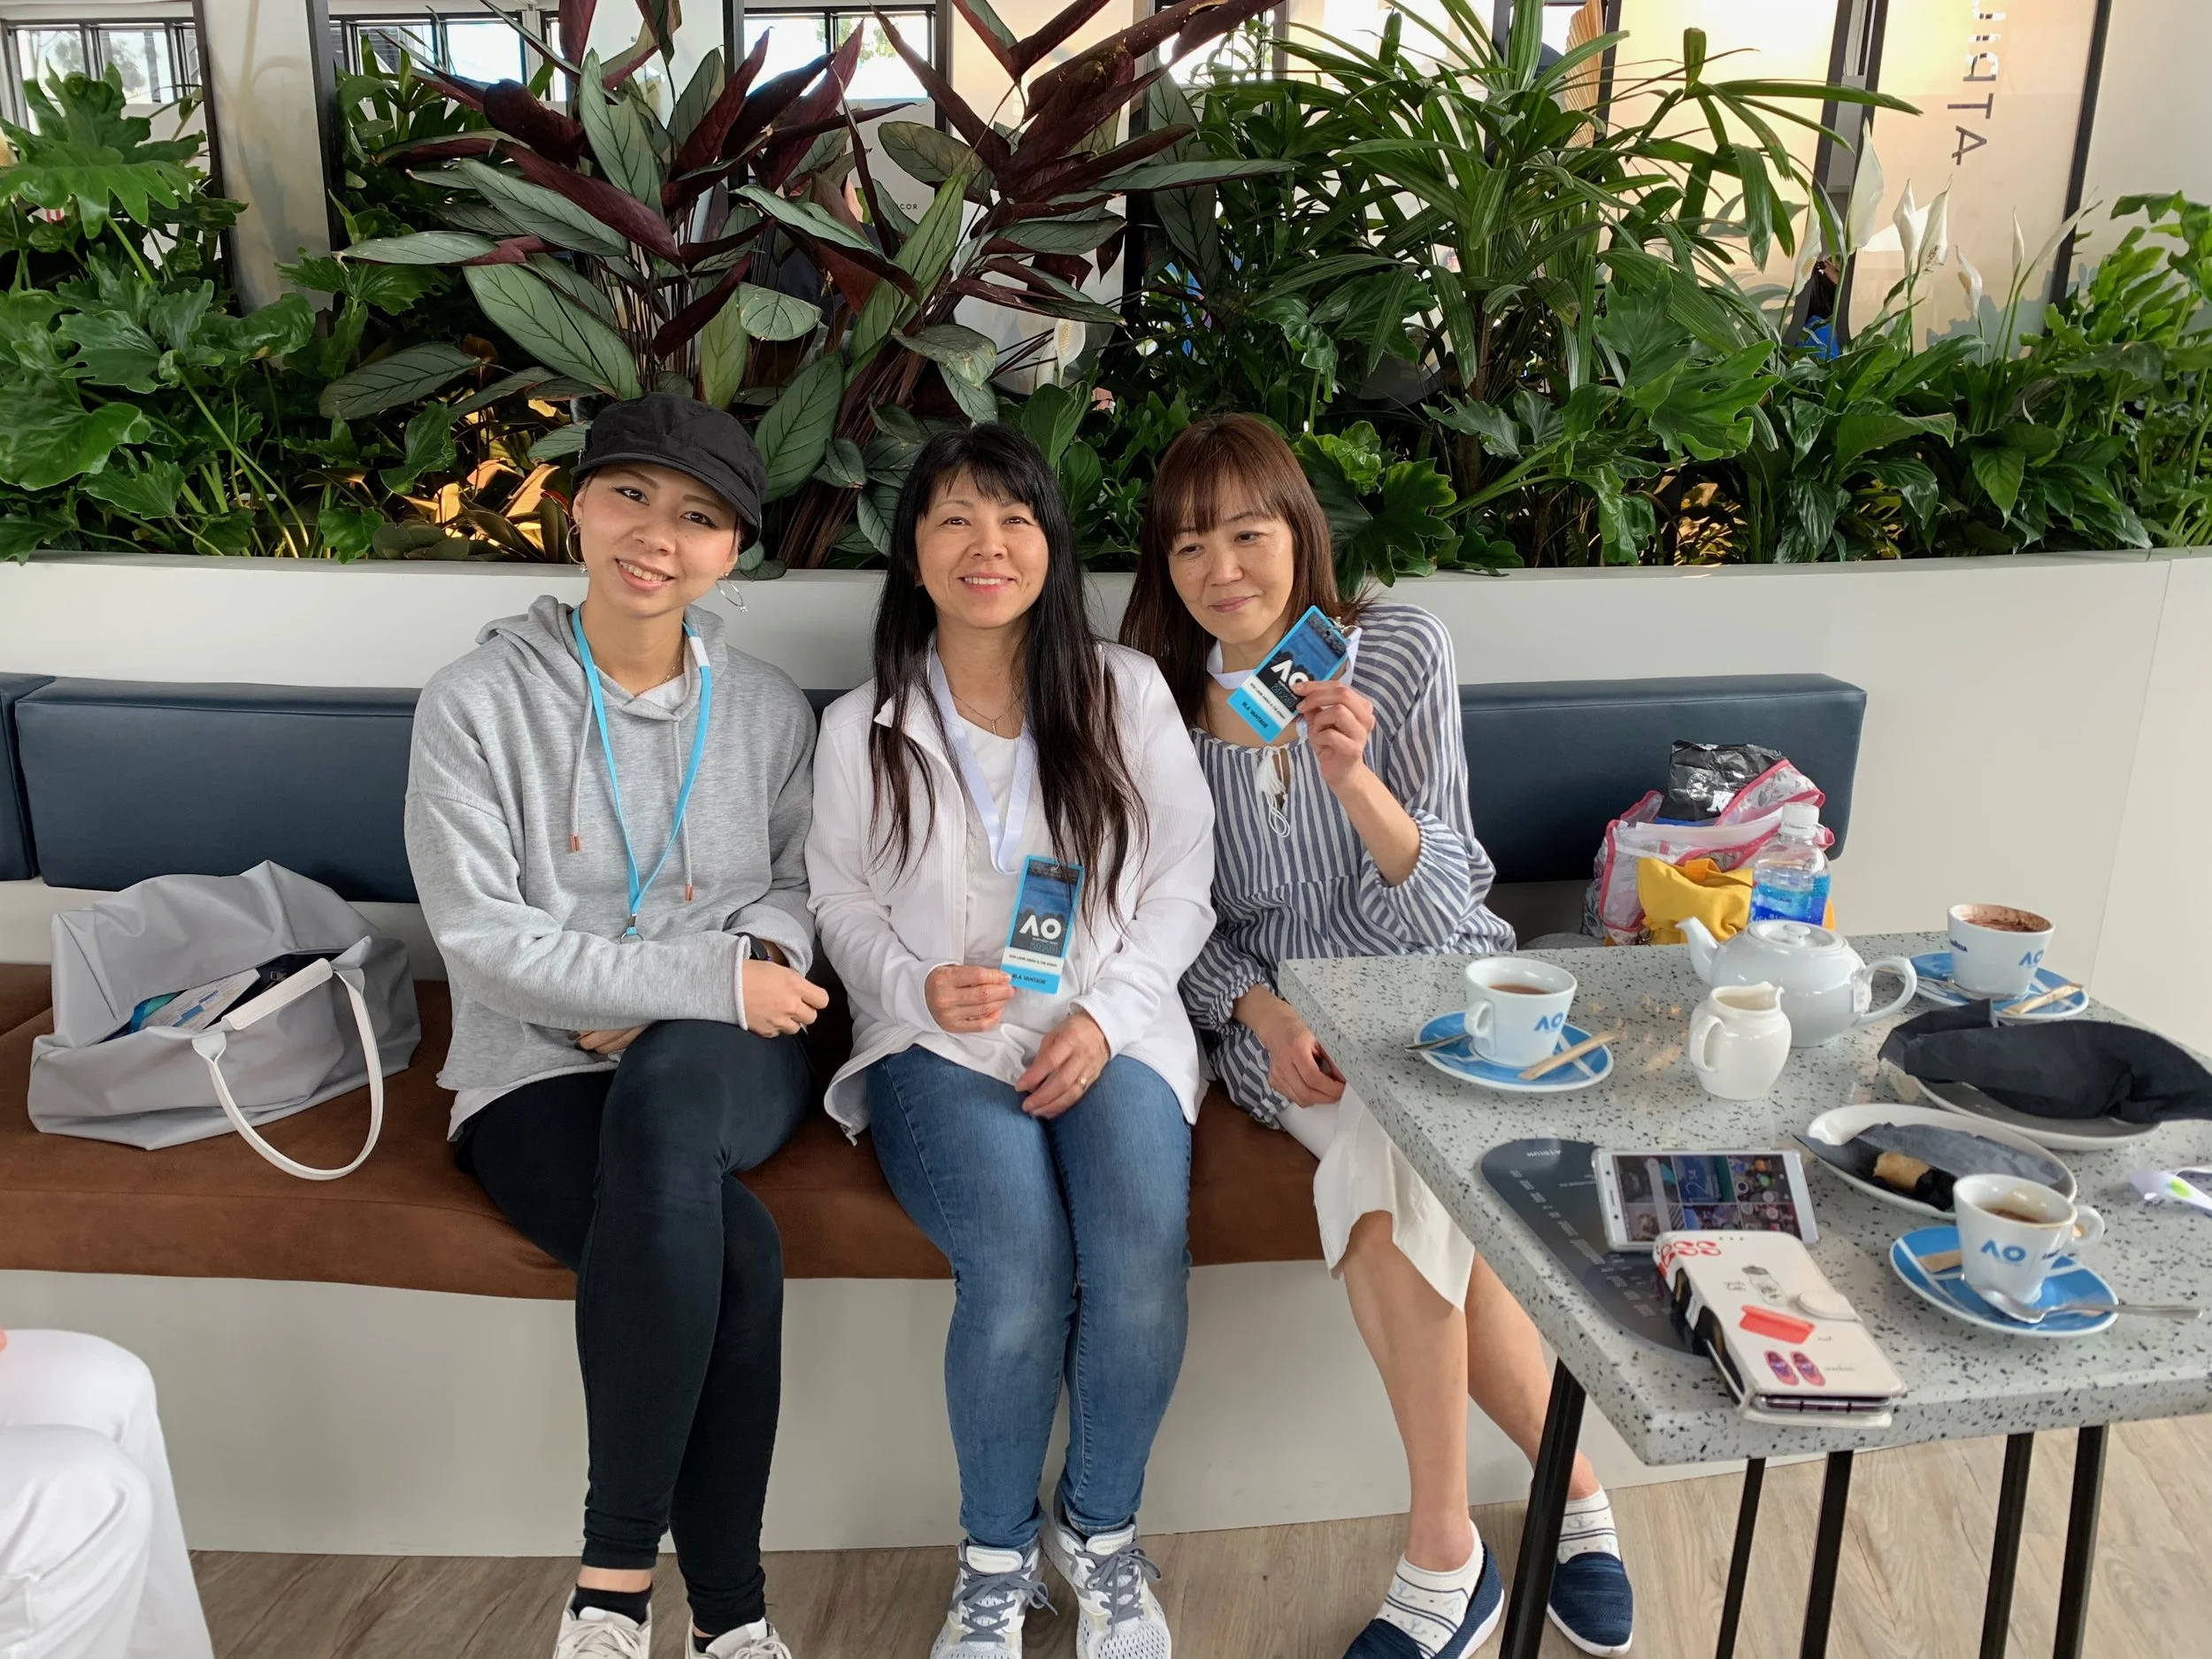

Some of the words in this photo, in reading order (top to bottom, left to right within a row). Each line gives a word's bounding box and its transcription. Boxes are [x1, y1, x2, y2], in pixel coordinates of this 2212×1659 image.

[1019, 914, 1061, 940] AO
[2018, 949, 2045, 966] AO
[1533, 1012, 1564, 1032] AO
[1981, 1240, 2026, 1262] AO
